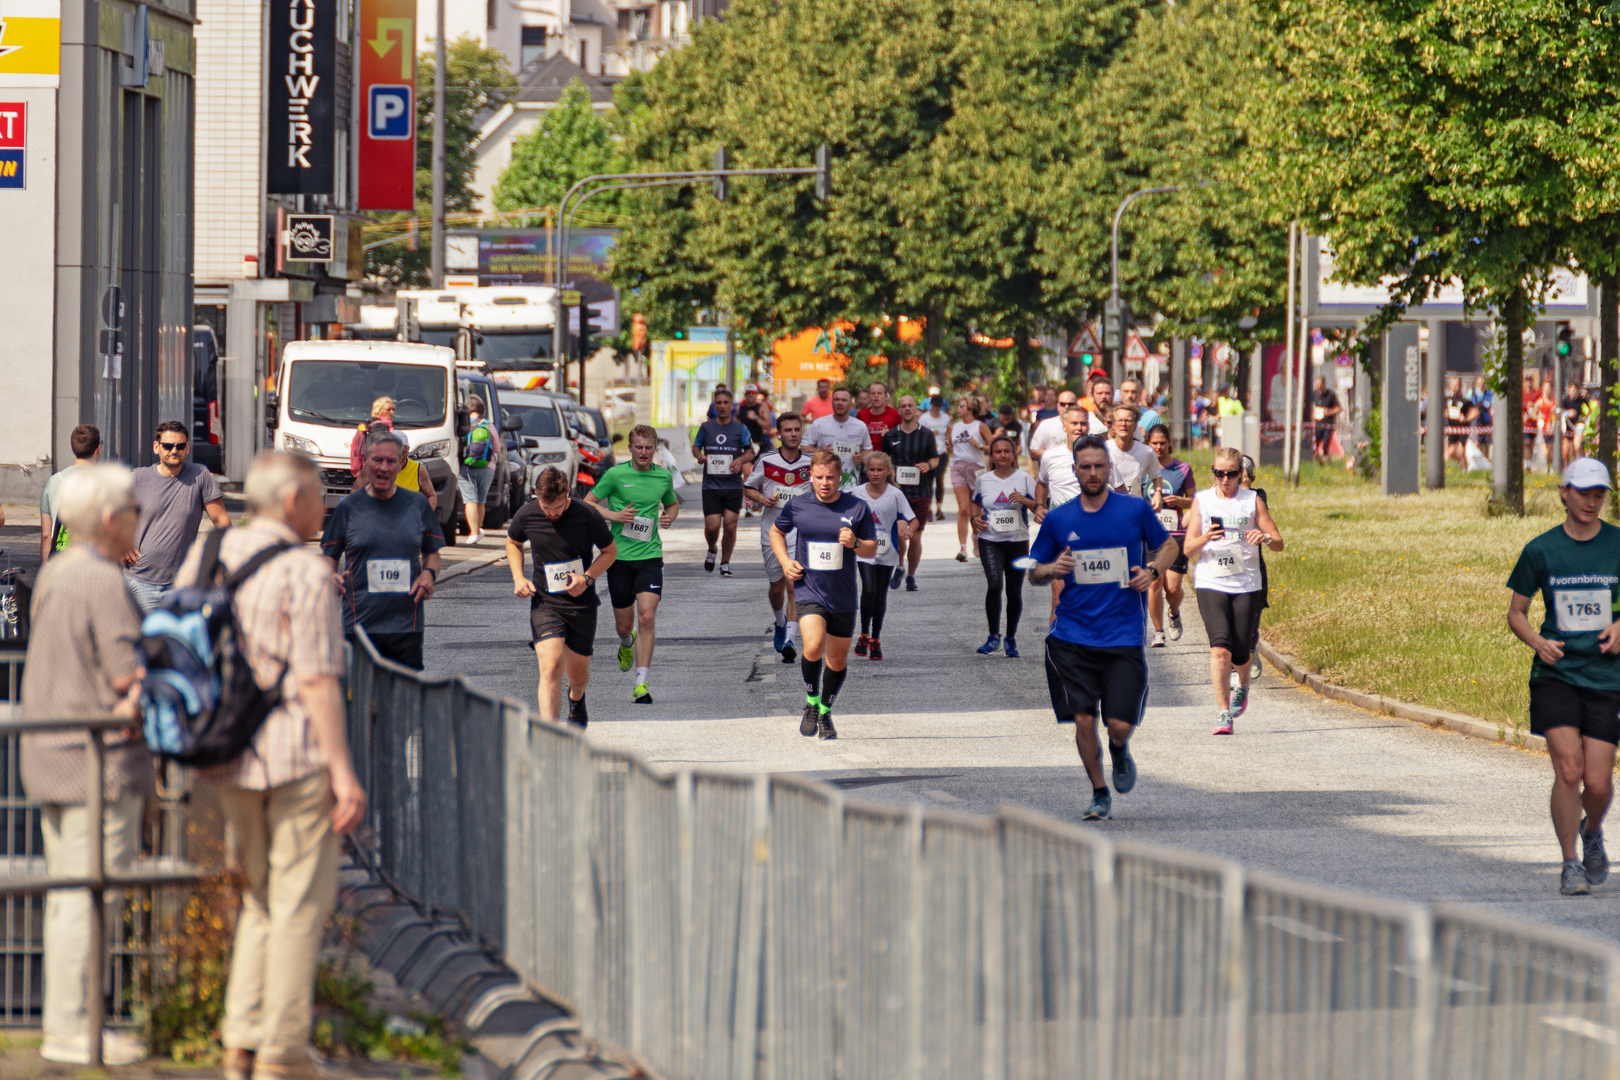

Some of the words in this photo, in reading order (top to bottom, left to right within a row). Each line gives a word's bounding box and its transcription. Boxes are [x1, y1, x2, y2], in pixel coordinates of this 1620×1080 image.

[375, 94, 405, 130] P
[995, 516, 1015, 525] 2608
[630, 522, 650, 533] 1687
[819, 551, 832, 561] 48
[1081, 559, 1111, 572] 1440
[379, 569, 400, 581] 109
[1566, 602, 1602, 617] 1763
